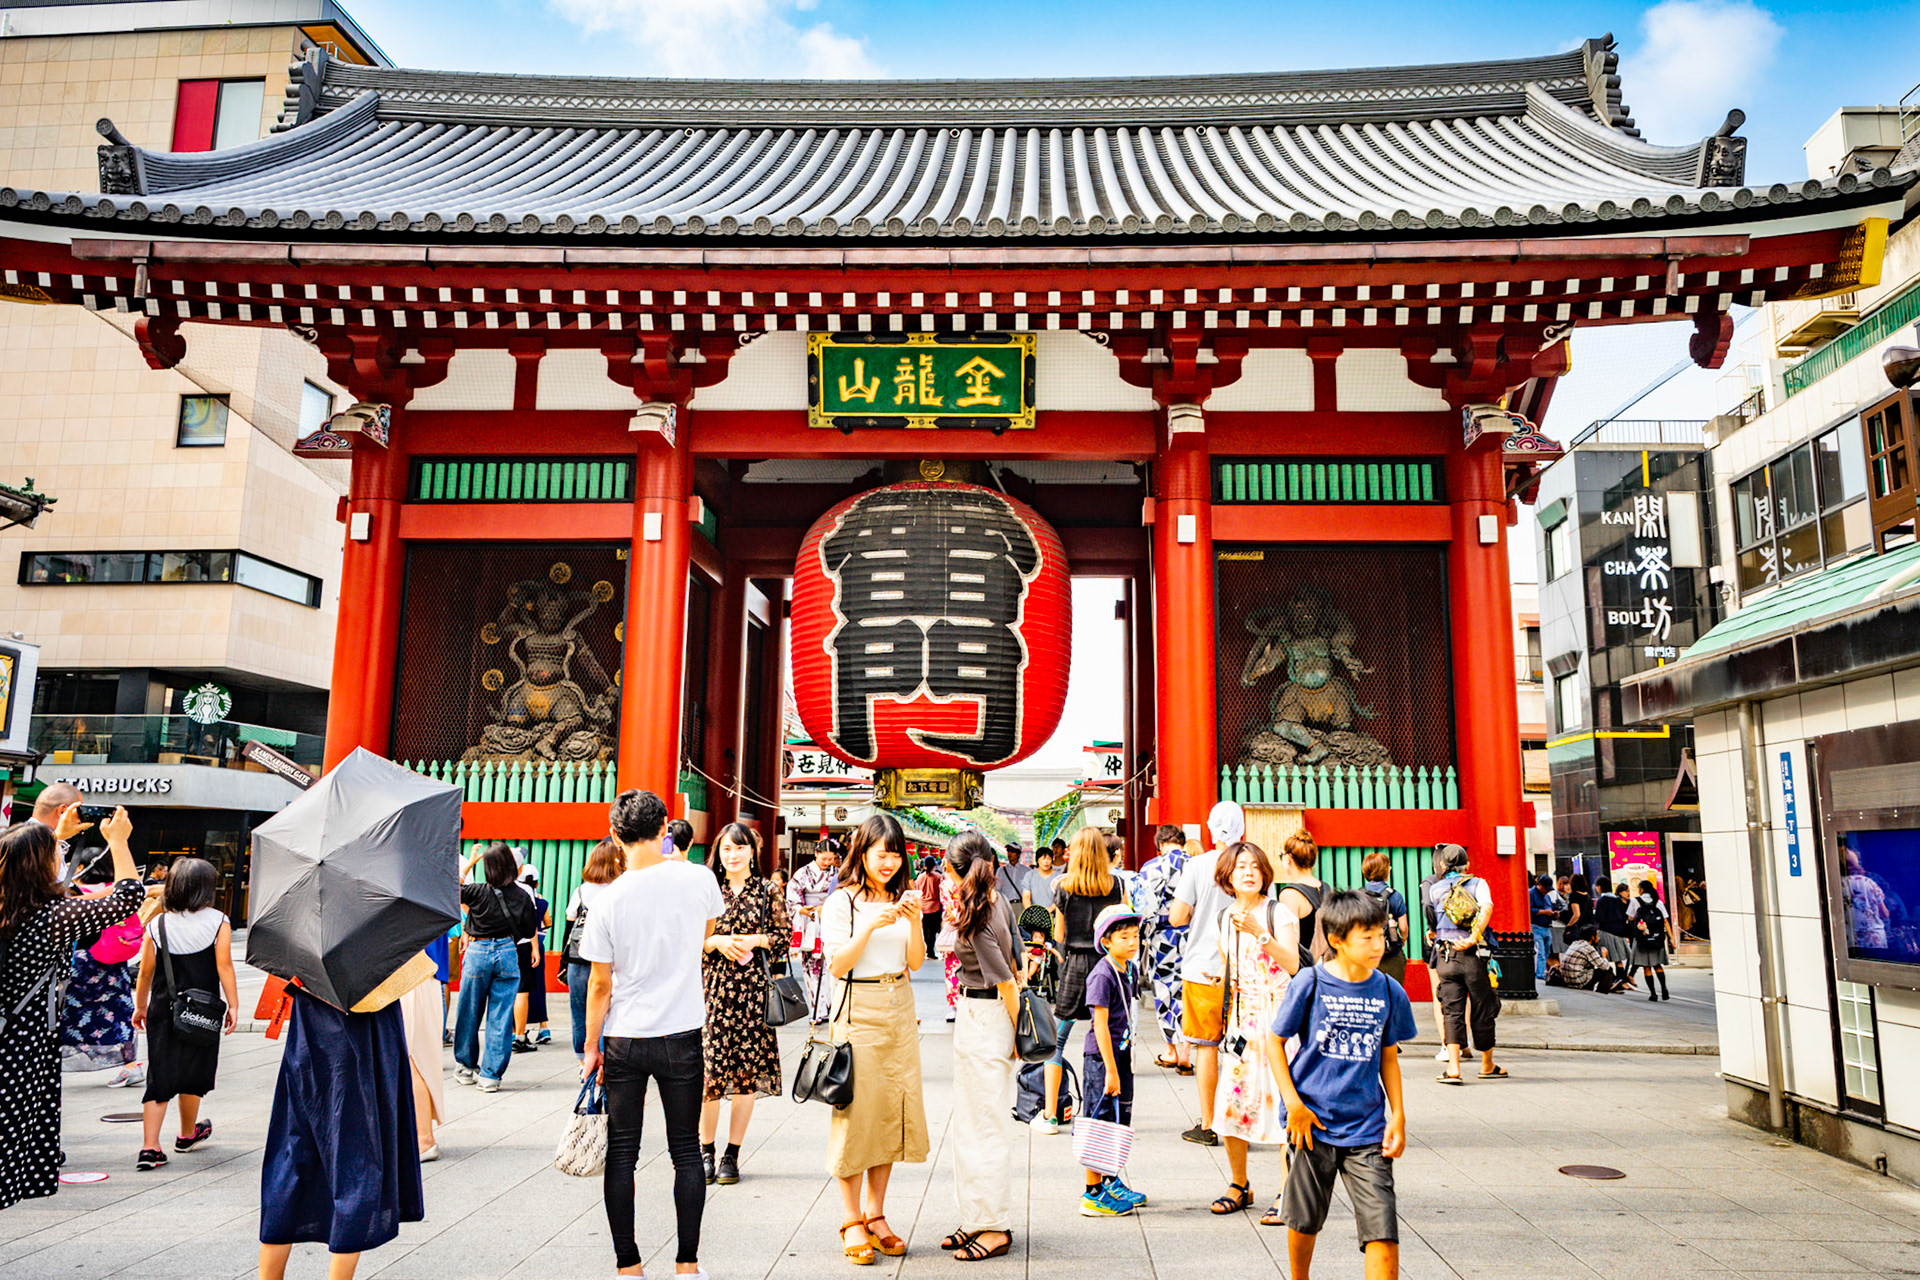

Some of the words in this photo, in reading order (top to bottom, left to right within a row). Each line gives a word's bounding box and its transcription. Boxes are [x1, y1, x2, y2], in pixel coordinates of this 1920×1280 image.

[1601, 511, 1634, 525] KAN
[1604, 561, 1638, 575] CHA
[1608, 611, 1641, 625] BOU
[818, 488, 1043, 765] 雷門
[254, 746, 295, 774] KAMINARIMON
[294, 770, 311, 784] GATE
[1791, 854, 1798, 868] 3
[1338, 995, 1364, 1004] about
[1370, 997, 1386, 1008] dog
